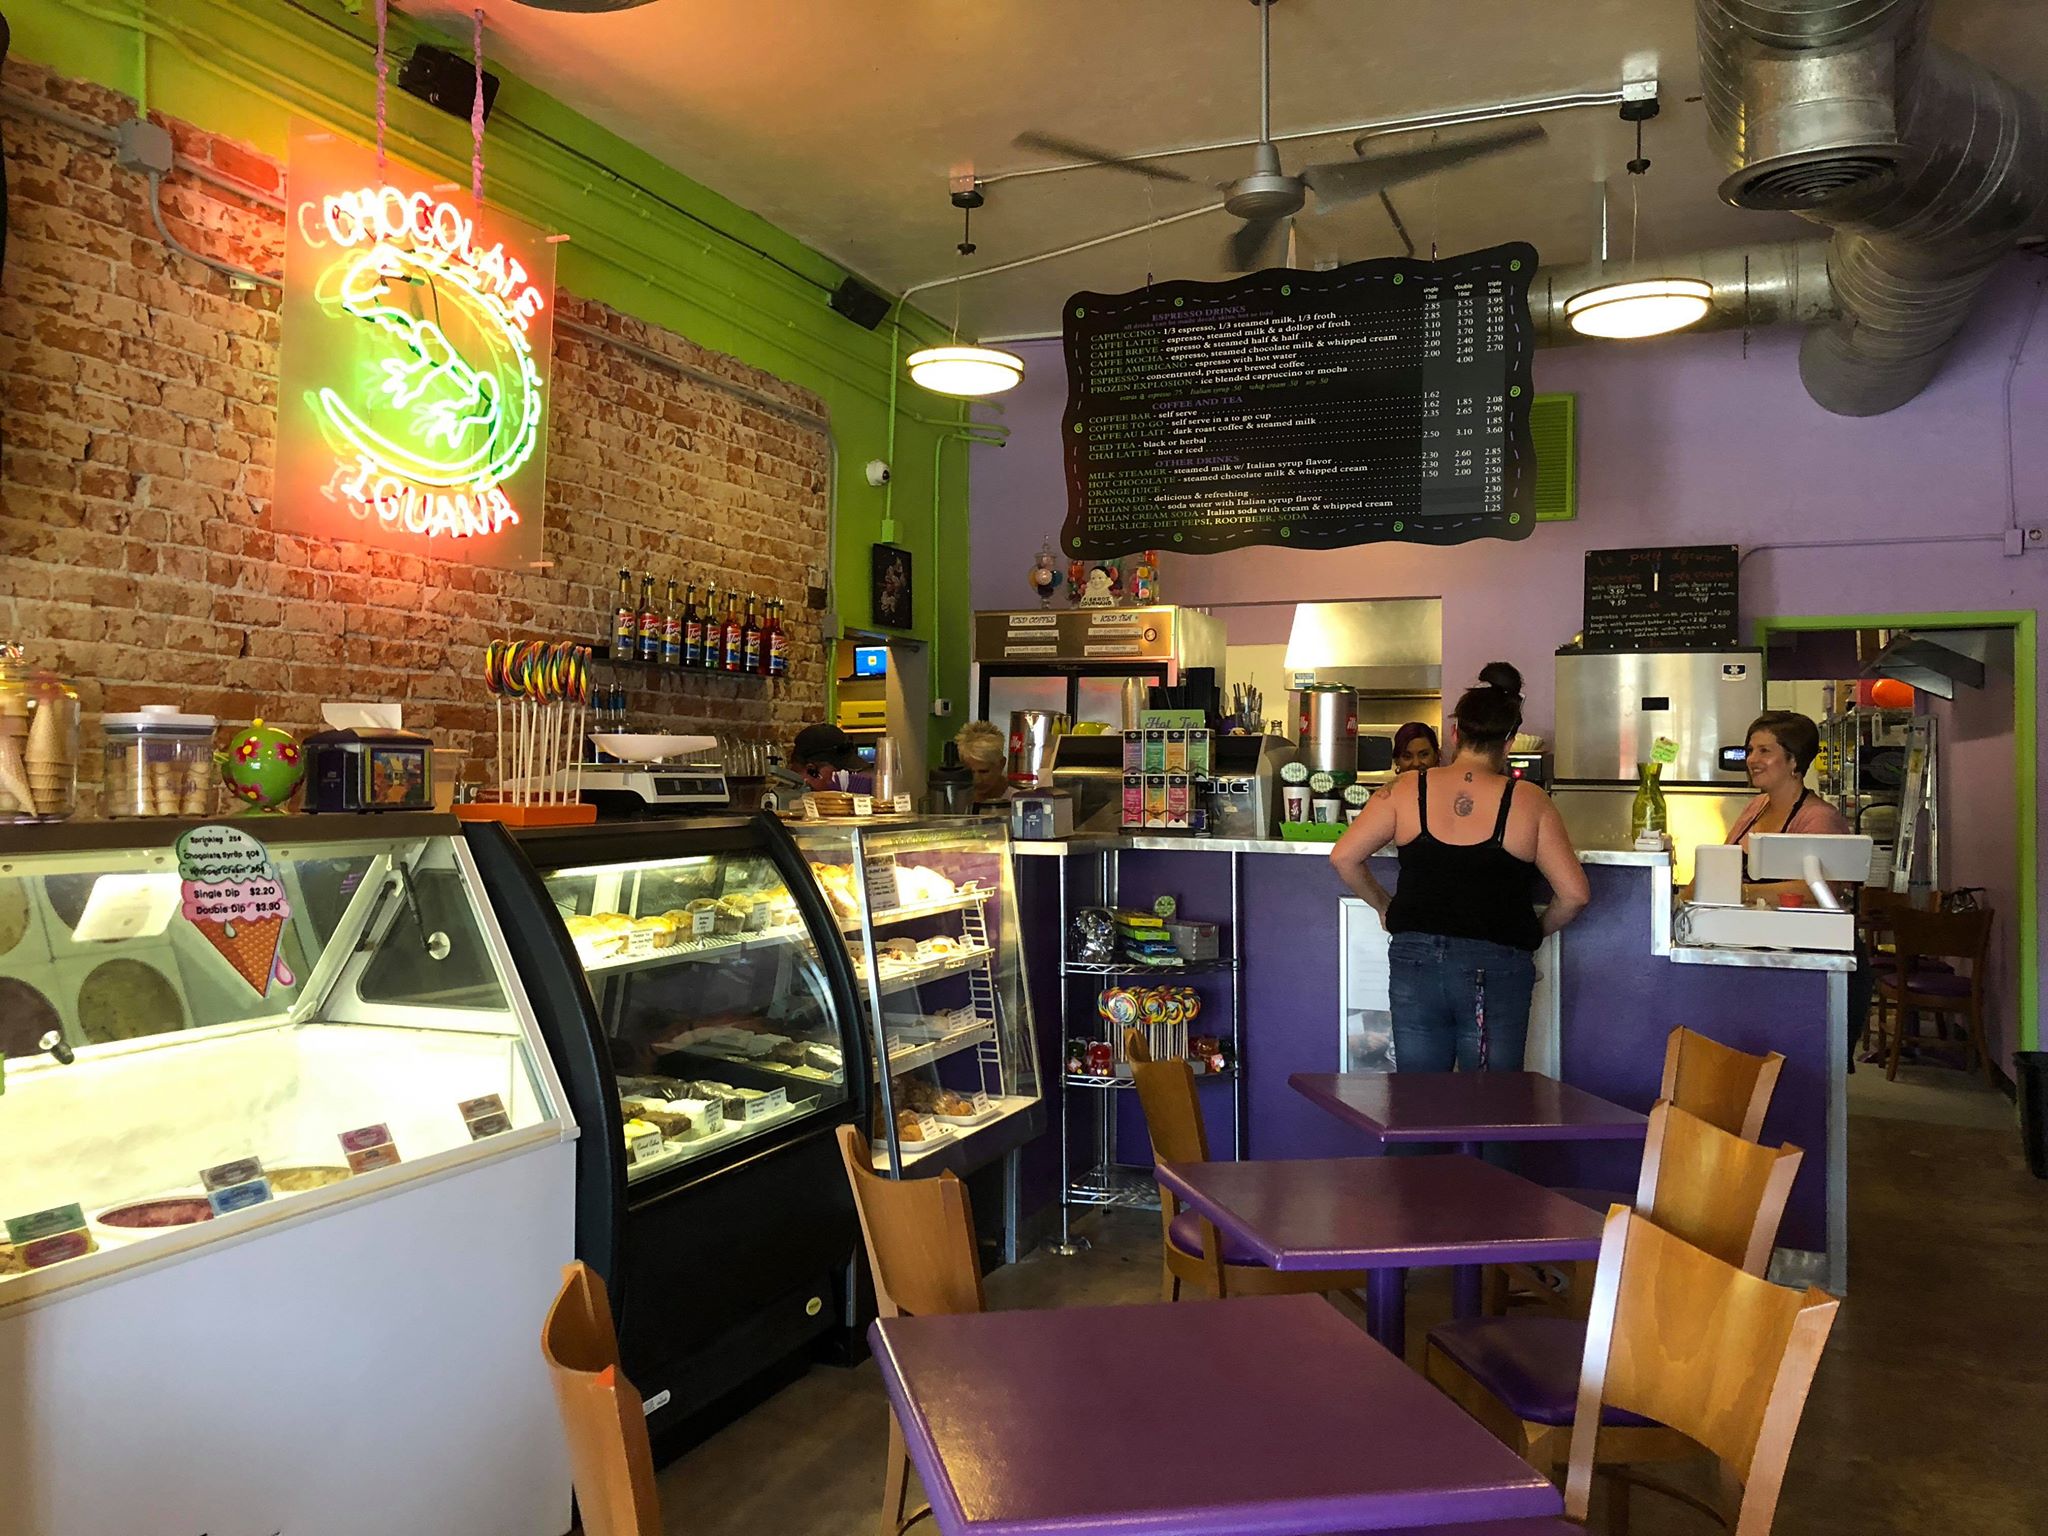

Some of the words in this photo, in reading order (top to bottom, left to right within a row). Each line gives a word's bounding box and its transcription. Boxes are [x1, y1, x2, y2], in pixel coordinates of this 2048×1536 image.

[322, 186, 545, 318] CHOCOLATE
[1090, 329, 1155, 342] CAPPUCCINO
[1164, 327, 1175, 335] 1/3
[1177, 325, 1215, 336] espresso,
[1219, 322, 1231, 330] 1/3
[1233, 318, 1269, 329] steamed
[1271, 316, 1295, 327] milk,
[1298, 314, 1311, 322] 1/3
[1313, 312, 1336, 321] froth
[1487, 297, 1503, 305] 3.95
[1090, 341, 1122, 351] CAFFE
[1125, 338, 1158, 348] LATTE
[1166, 335, 1204, 345] espresso,
[1206, 330, 1242, 340] steamed
[1244, 328, 1265, 336] milk
[1285, 323, 1314, 334] dollop
[1328, 319, 1350, 328] froth
[1487, 306, 1503, 314] 3.95
[1090, 350, 1122, 360] CAFFE
[1125, 346, 1157, 356] BREVE
[1165, 344, 1201, 354] espresso
[1213, 338, 1248, 348] steamed
[1251, 336, 1269, 344] half
[1281, 333, 1299, 341] half
[1090, 358, 1122, 368] CAFFE
[1125, 354, 1162, 364] MOCHA
[1170, 352, 1208, 362] espresso,
[1210, 347, 1246, 357] steamed
[1248, 343, 1290, 354] chocolate
[1292, 341, 1313, 350] milk
[1327, 336, 1366, 348] whipped
[1369, 335, 1397, 343] cream
[1090, 367, 1122, 376] CAFFE
[1125, 361, 1187, 373] AMERICANO
[1194, 359, 1230, 369] espresso
[1232, 355, 1252, 364] with
[1255, 354, 1269, 362] hot
[1272, 351, 1296, 360] water
[1090, 374, 1138, 385] ESPRESSO
[1146, 368, 1203, 382] concentrated,
[1206, 366, 1242, 377] pressure
[1244, 362, 1276, 372] brewed
[1278, 360, 1304, 369] coffee
[1090, 383, 1130, 394] FROZEN
[1133, 378, 1192, 390] EXPLOSION
[1200, 376, 1212, 384] ice
[1215, 373, 1250, 383] blended
[1252, 369, 1302, 382] cappuccino
[1317, 365, 1347, 374] mocha
[1152, 400, 1192, 410] COFFEE
[1195, 398, 1218, 407] AND
[1221, 396, 1242, 404] TEA
[1088, 414, 1128, 423] COFFEE
[1130, 412, 1150, 420] BAR
[1158, 410, 1174, 418] self
[1088, 423, 1128, 432] COFFEE
[1171, 418, 1186, 426] self
[1242, 415, 1253, 423] go
[1255, 414, 1271, 422] cup
[1088, 432, 1121, 441] CAFFE
[1140, 429, 1163, 437] LAIT
[1173, 427, 1192, 435] dark
[1195, 425, 1215, 433] roast
[1217, 423, 1243, 432] coffee
[1256, 419, 1292, 429] steamed
[1295, 418, 1316, 426] milk
[1486, 405, 1503, 413] 2.90
[1088, 452, 1113, 460] CHAI
[1116, 449, 1149, 458] LATTE
[1185, 446, 1203, 454] iced
[1089, 443, 1113, 452] ICED
[1117, 442, 1135, 450] TEA
[1143, 440, 1165, 448] black
[1179, 437, 1206, 445] herbal
[1088, 471, 1115, 479] MILK
[1118, 468, 1166, 478] STEAMER
[1173, 465, 1208, 474] steamed
[1211, 464, 1231, 472] milk
[1246, 461, 1275, 470] Italian
[1277, 461, 1303, 469] syrup
[1305, 457, 1331, 466] flavor
[1088, 480, 1110, 488] HOT
[1112, 476, 1175, 487] CHOCOLATE
[1183, 473, 1218, 482] steamed
[1220, 470, 1261, 480] chocolate
[1264, 469, 1284, 477] milk
[1298, 466, 1337, 477] whipped
[342, 455, 520, 538] IGUANA
[1088, 487, 1129, 496] ORANGE
[1132, 486, 1160, 494] JUICE
[1088, 495, 1145, 505] LEMONADE
[1153, 493, 1191, 502] delicious
[1204, 490, 1248, 501] refreshing
[1088, 505, 1129, 514] ITALIAN
[1132, 503, 1159, 511] SODA
[1188, 500, 1212, 508] water
[1214, 499, 1234, 507] with
[1237, 497, 1265, 506] Italian
[1268, 497, 1293, 506] syrup
[1295, 494, 1321, 502] flavor
[1088, 513, 1129, 522] ITALIAN
[1131, 511, 1167, 520] CREAM
[1171, 509, 1198, 518] SODA
[1206, 507, 1235, 516] Italian
[1237, 506, 1257, 514] soda
[1259, 505, 1279, 513] with
[1322, 500, 1362, 511] whipped
[1144, 716, 1171, 728] Hot
[1180, 716, 1199, 728] Tea
[194, 890, 222, 898] Single
[225, 888, 240, 897] Dip
[250, 886, 275, 896] $2.20
[196, 906, 228, 915] Double
[231, 904, 246, 913] Dip
